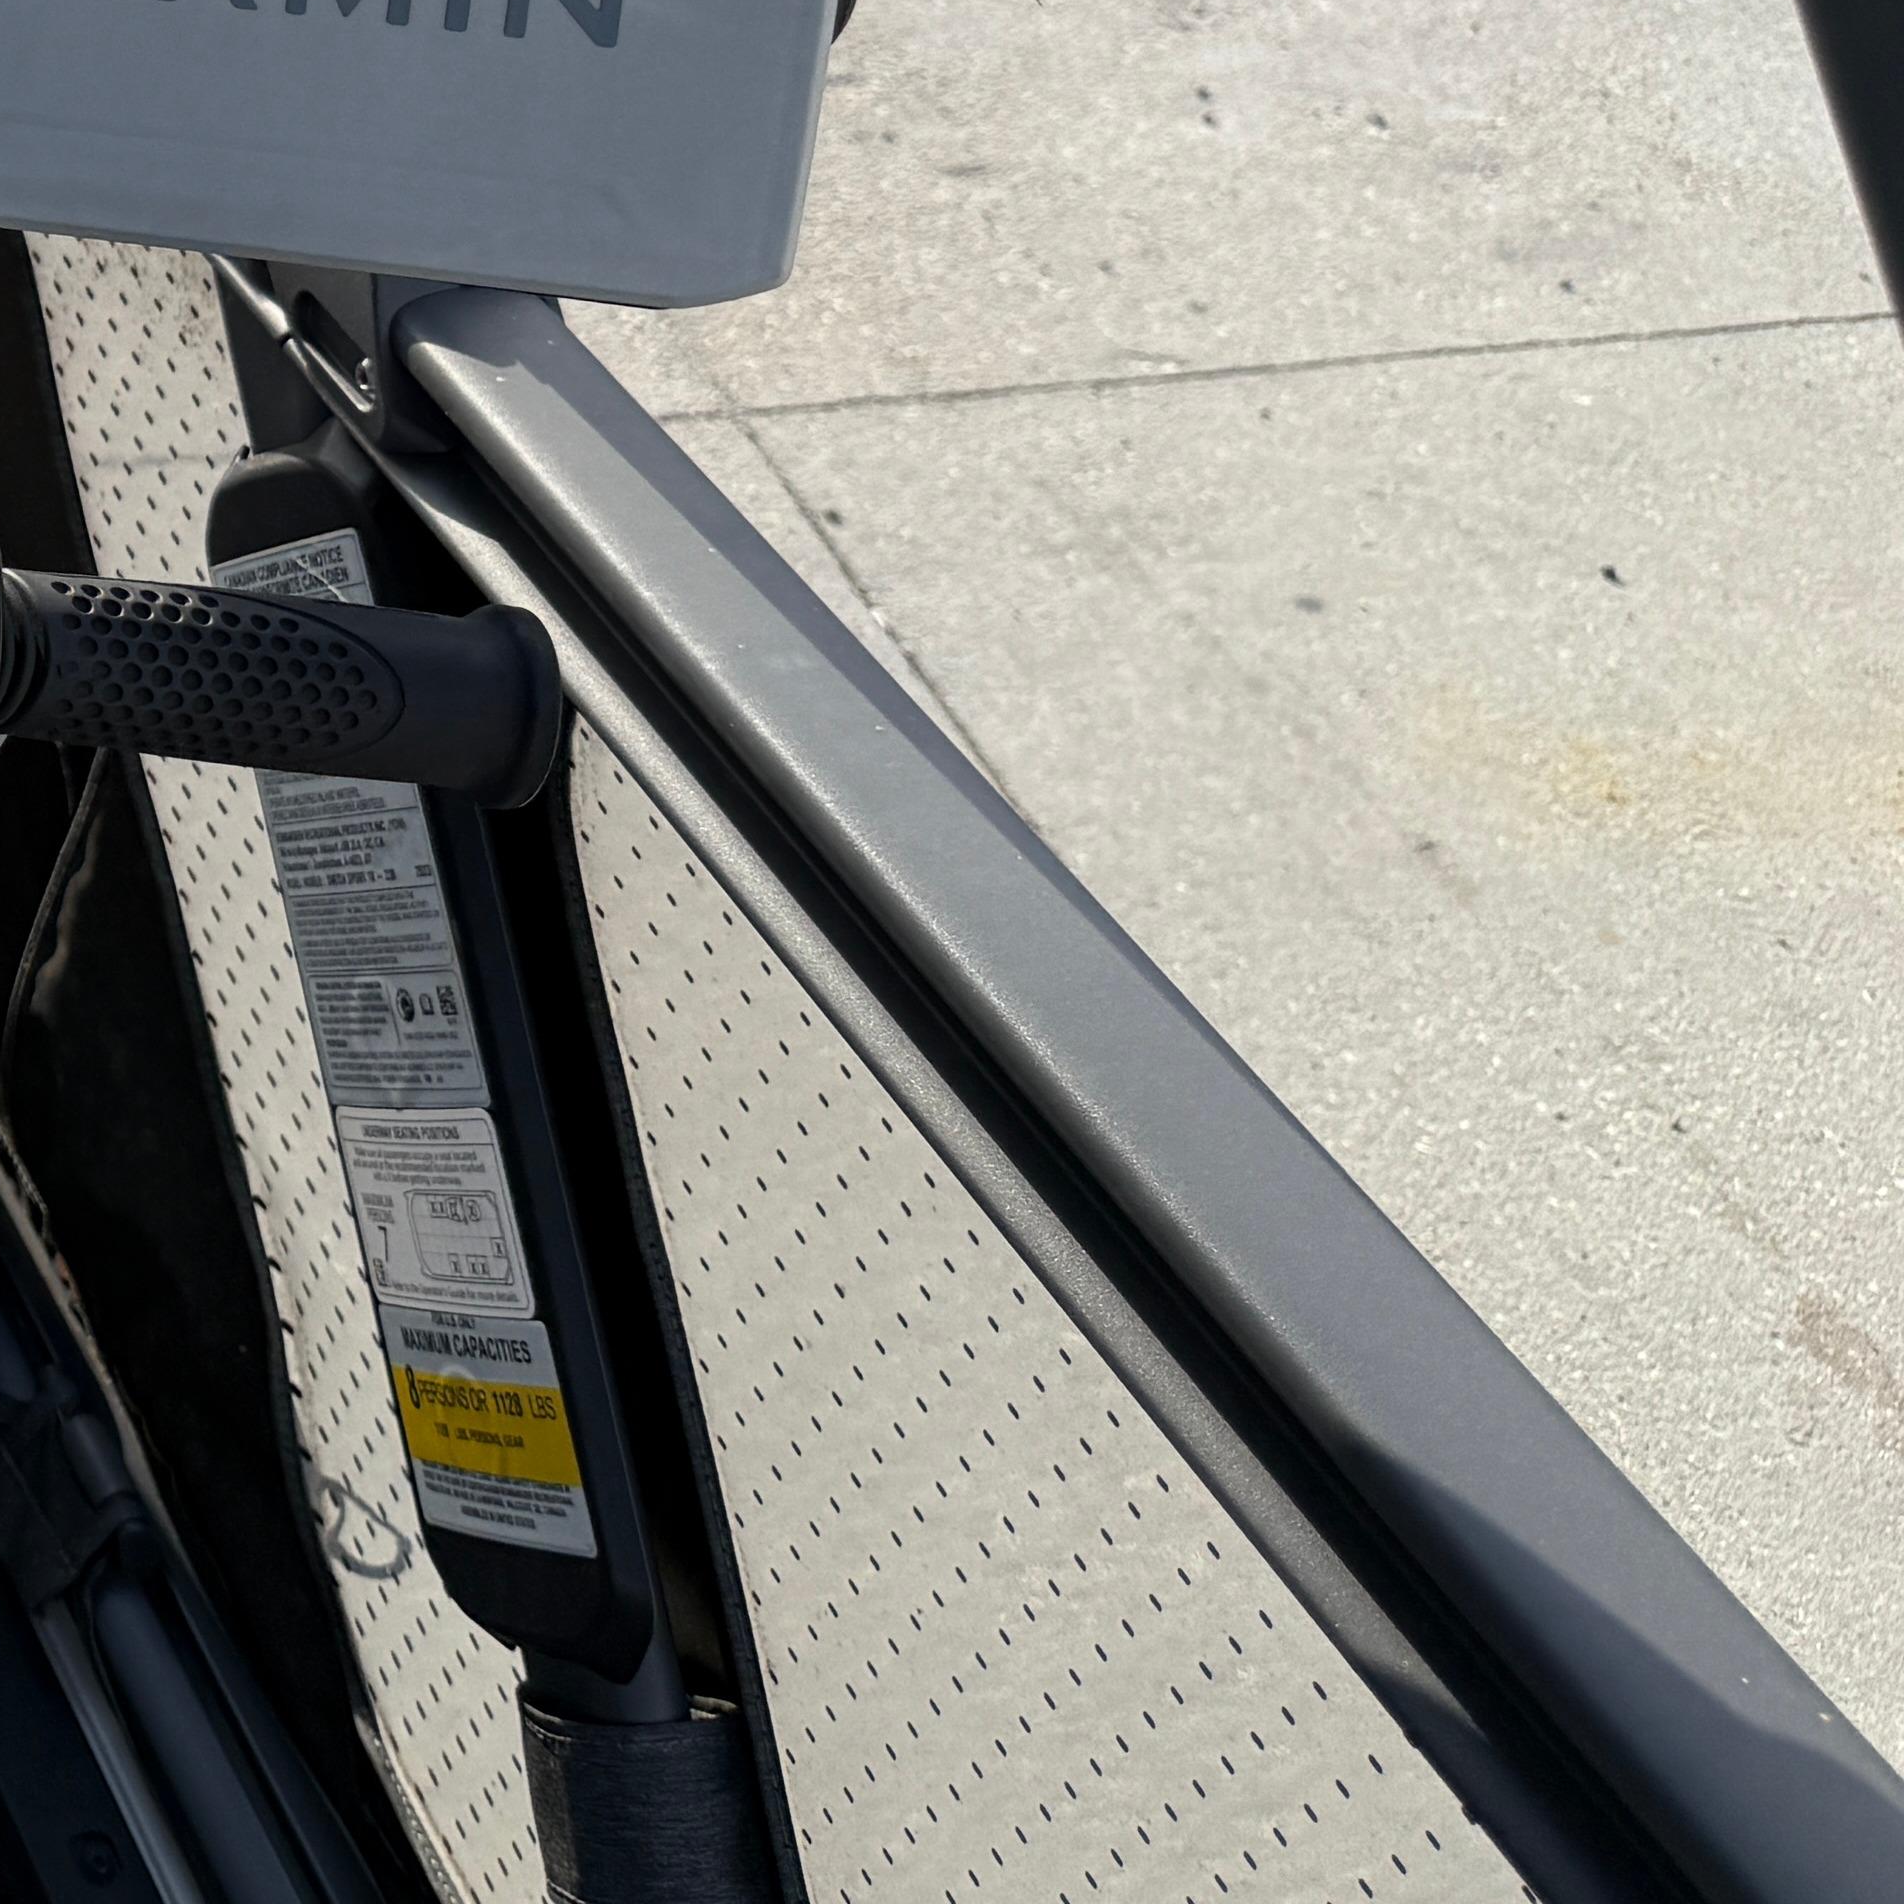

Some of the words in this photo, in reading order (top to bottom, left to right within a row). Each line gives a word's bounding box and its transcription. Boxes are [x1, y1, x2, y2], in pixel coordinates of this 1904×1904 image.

[378, 1225, 389, 1263] 7
[402, 1327, 451, 1354] MAXIMUM
[453, 1334, 531, 1364] CAPACITIES
[405, 1363, 418, 1407] 8
[420, 1380, 469, 1409] PERSONS
[470, 1387, 489, 1411] OR
[528, 1395, 558, 1420] LBS
